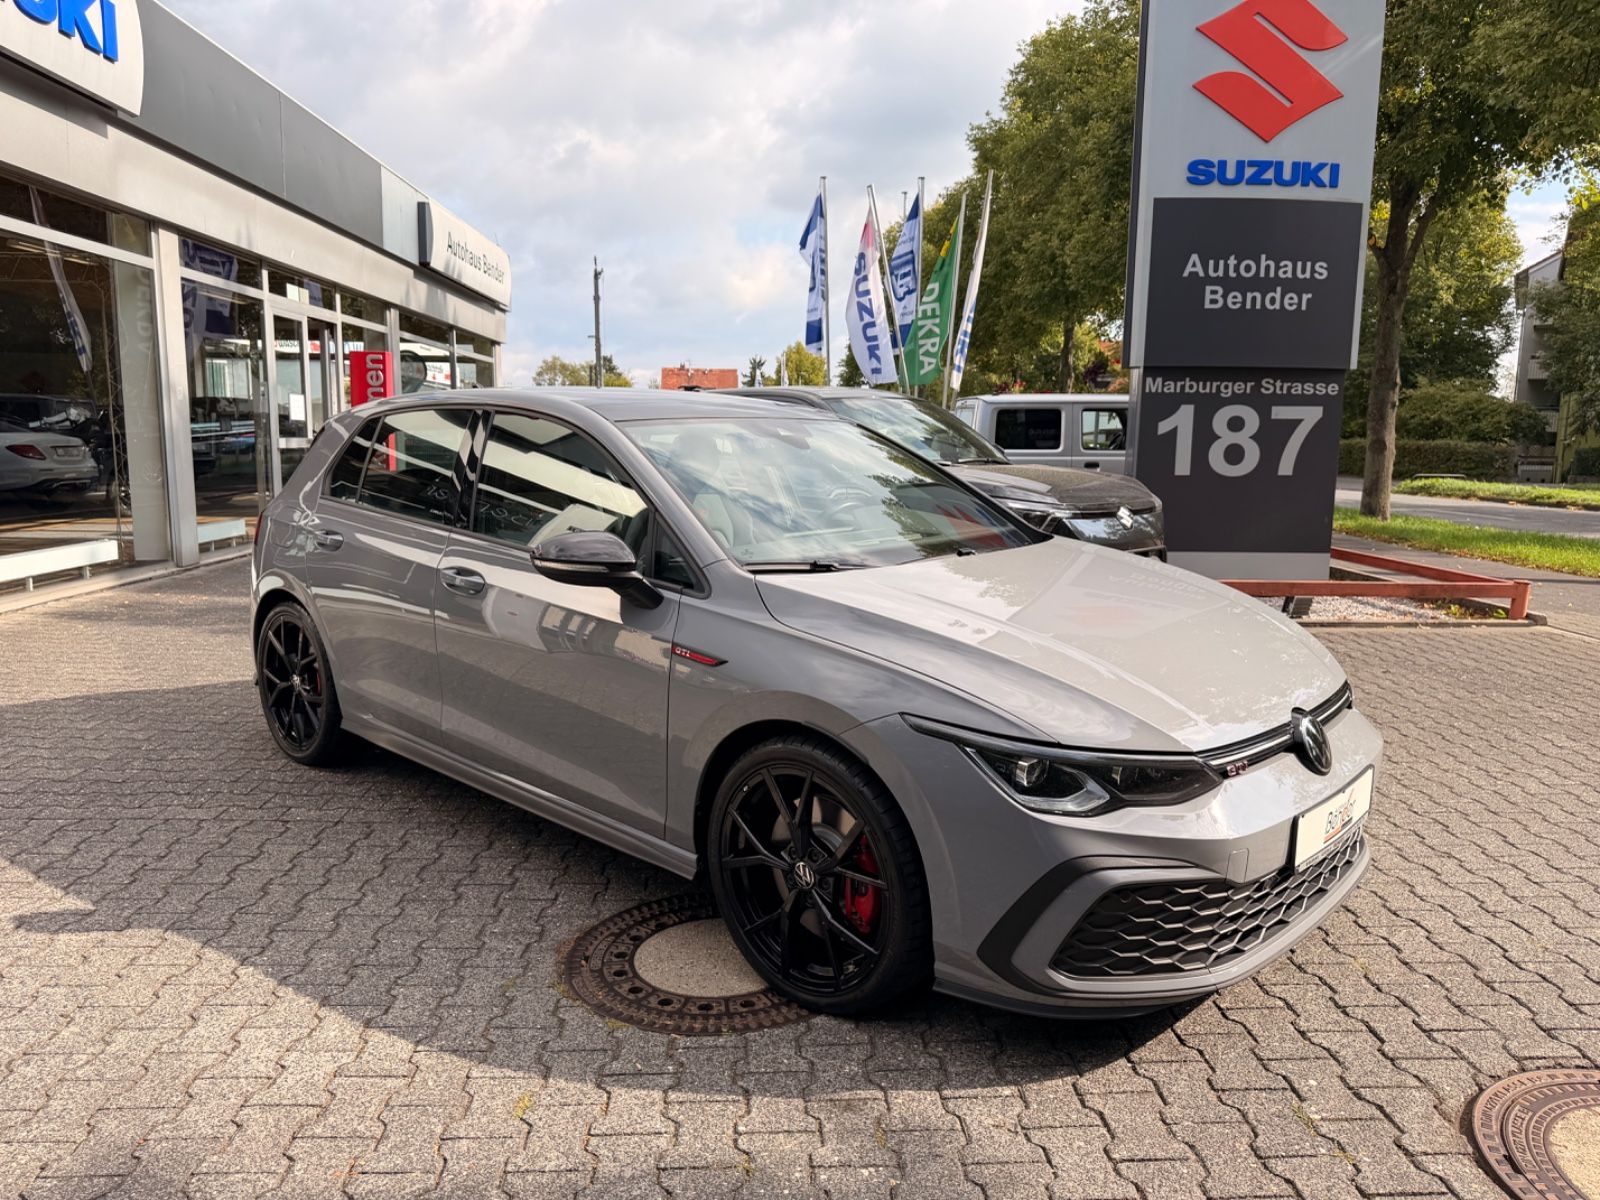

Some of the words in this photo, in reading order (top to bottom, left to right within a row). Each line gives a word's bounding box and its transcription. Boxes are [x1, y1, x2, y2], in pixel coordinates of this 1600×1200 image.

[1186, 159, 1340, 189] SUZUKI
[447, 231, 482, 270] Autohaus
[482, 253, 505, 285] Bender
[1182, 253, 1329, 280] Autohaus
[1203, 285, 1312, 311] Bender
[854, 252, 882, 375] SUZUKI
[917, 282, 940, 376] DEKRA
[1145, 376, 1254, 398] Marburger
[1260, 378, 1339, 396] Strasse
[1157, 403, 1324, 478] 187
[675, 646, 690, 657] GTI
[1226, 760, 1248, 776] GTI
